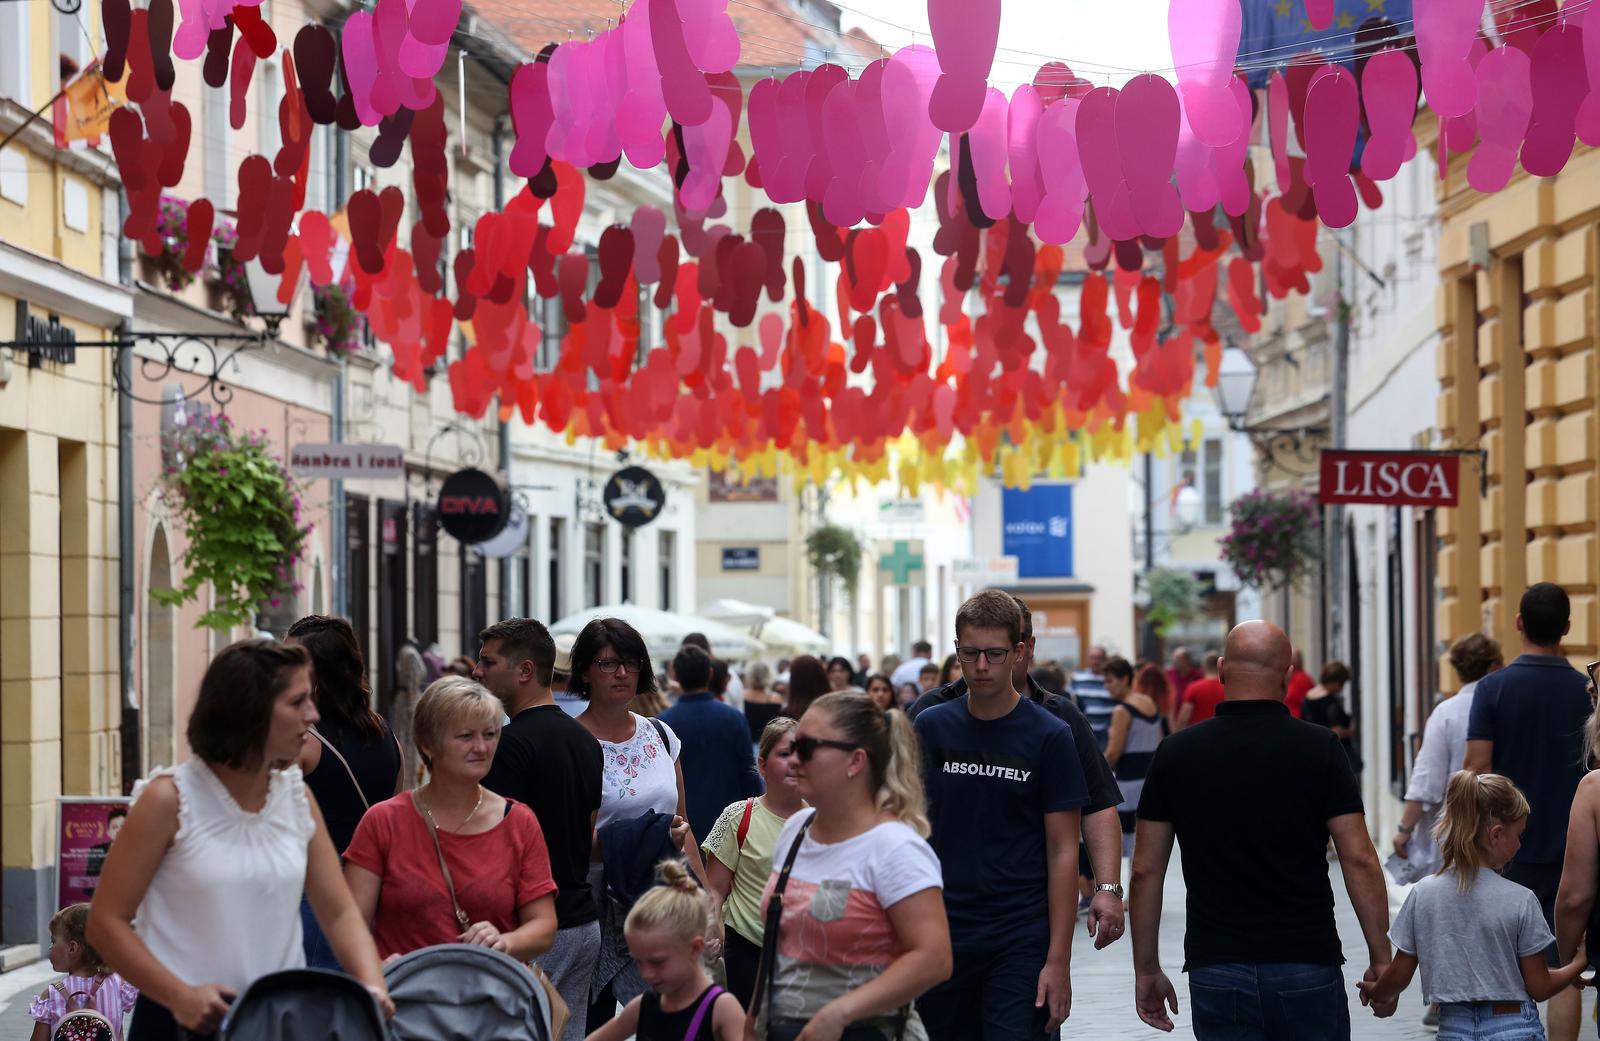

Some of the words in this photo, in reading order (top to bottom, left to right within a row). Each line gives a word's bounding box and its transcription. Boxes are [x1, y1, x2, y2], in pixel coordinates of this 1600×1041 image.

[1333, 461, 1452, 498] LISCA
[442, 496, 498, 513] DIVA
[942, 761, 1032, 782] ABSOLUTELY
